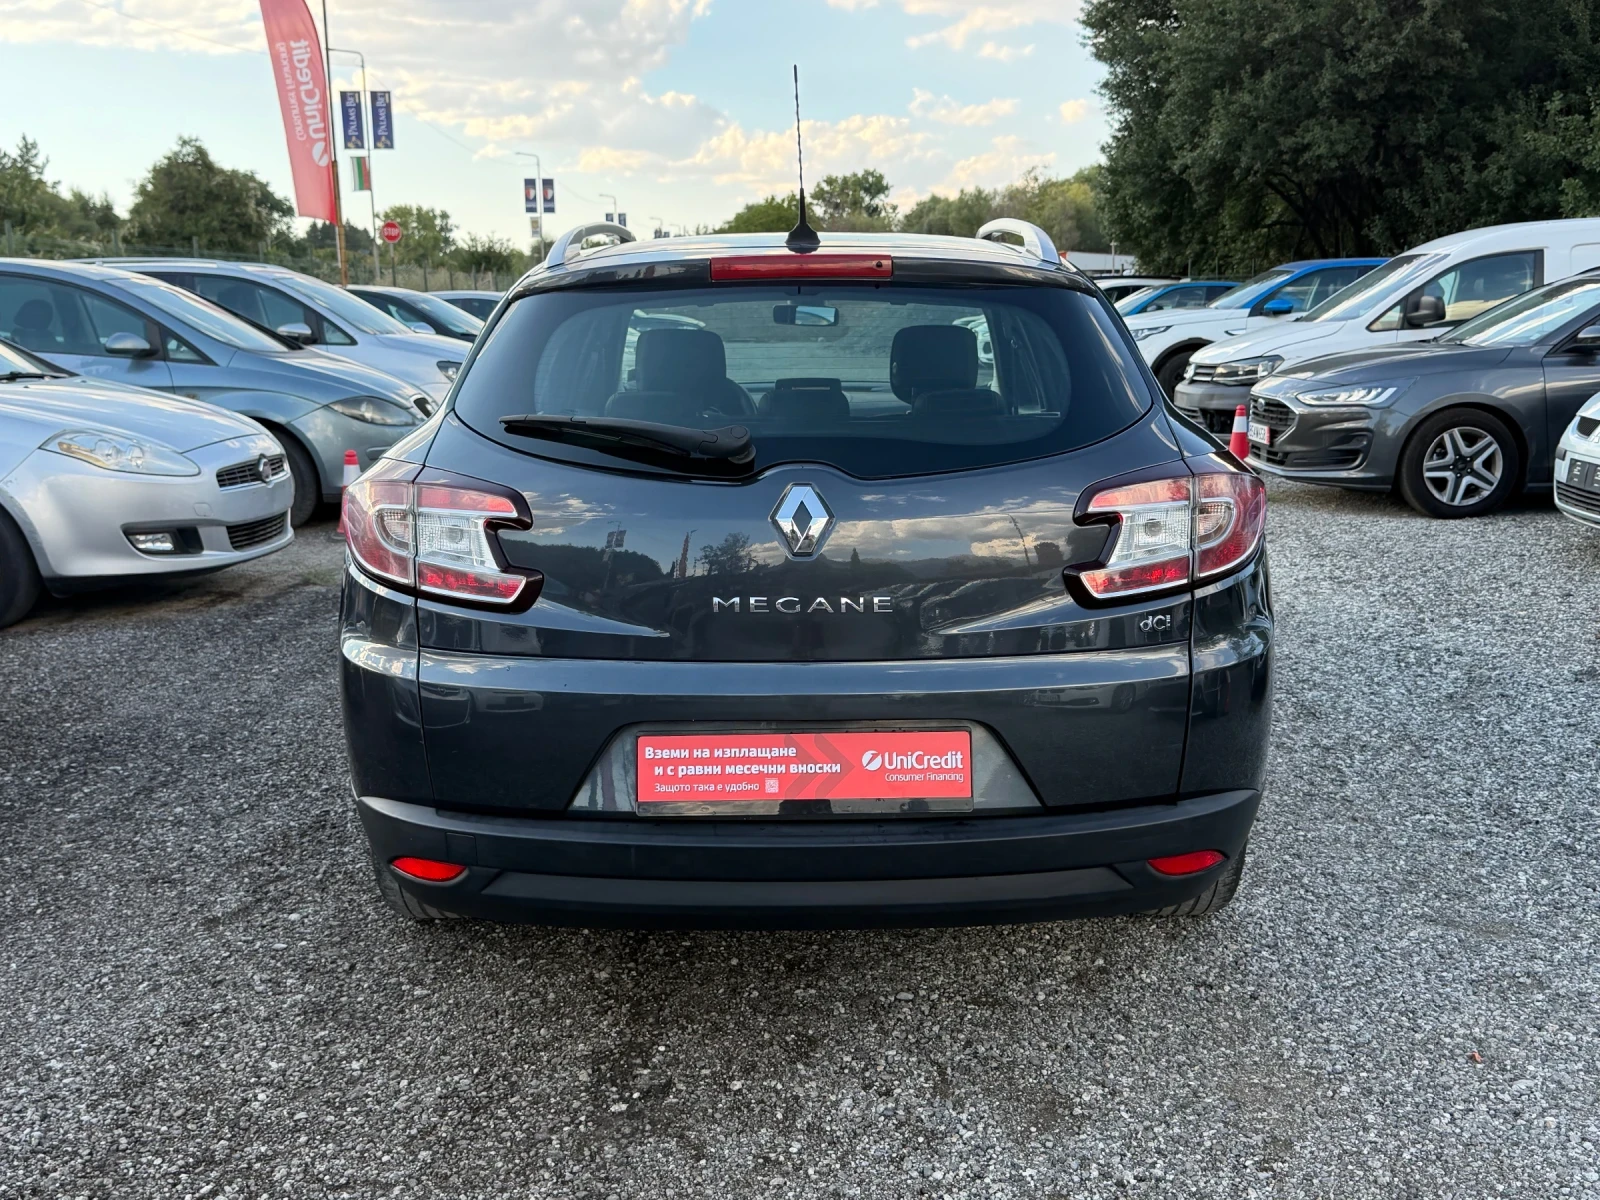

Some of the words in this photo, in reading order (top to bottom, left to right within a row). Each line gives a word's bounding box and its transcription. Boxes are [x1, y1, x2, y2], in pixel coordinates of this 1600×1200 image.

[347, 107, 359, 136] PALMS
[377, 107, 389, 136] PALMS
[383, 227, 399, 237] STOP
[712, 596, 894, 614] MEGANE
[645, 746, 690, 759] Вземи
[693, 748, 711, 759] на
[714, 746, 797, 760] изплащане
[884, 750, 964, 770] UniCredit
[654, 765, 664, 776] и
[667, 765, 675, 776] с
[678, 764, 722, 778] равни
[725, 763, 786, 775] месечни
[790, 763, 841, 774] вноски
[884, 772, 925, 782] Consumer
[926, 771, 964, 783] Financing
[654, 782, 691, 794] Защото
[693, 782, 715, 792] така
[717, 783, 723, 792] е
[725, 781, 760, 793] удобно
